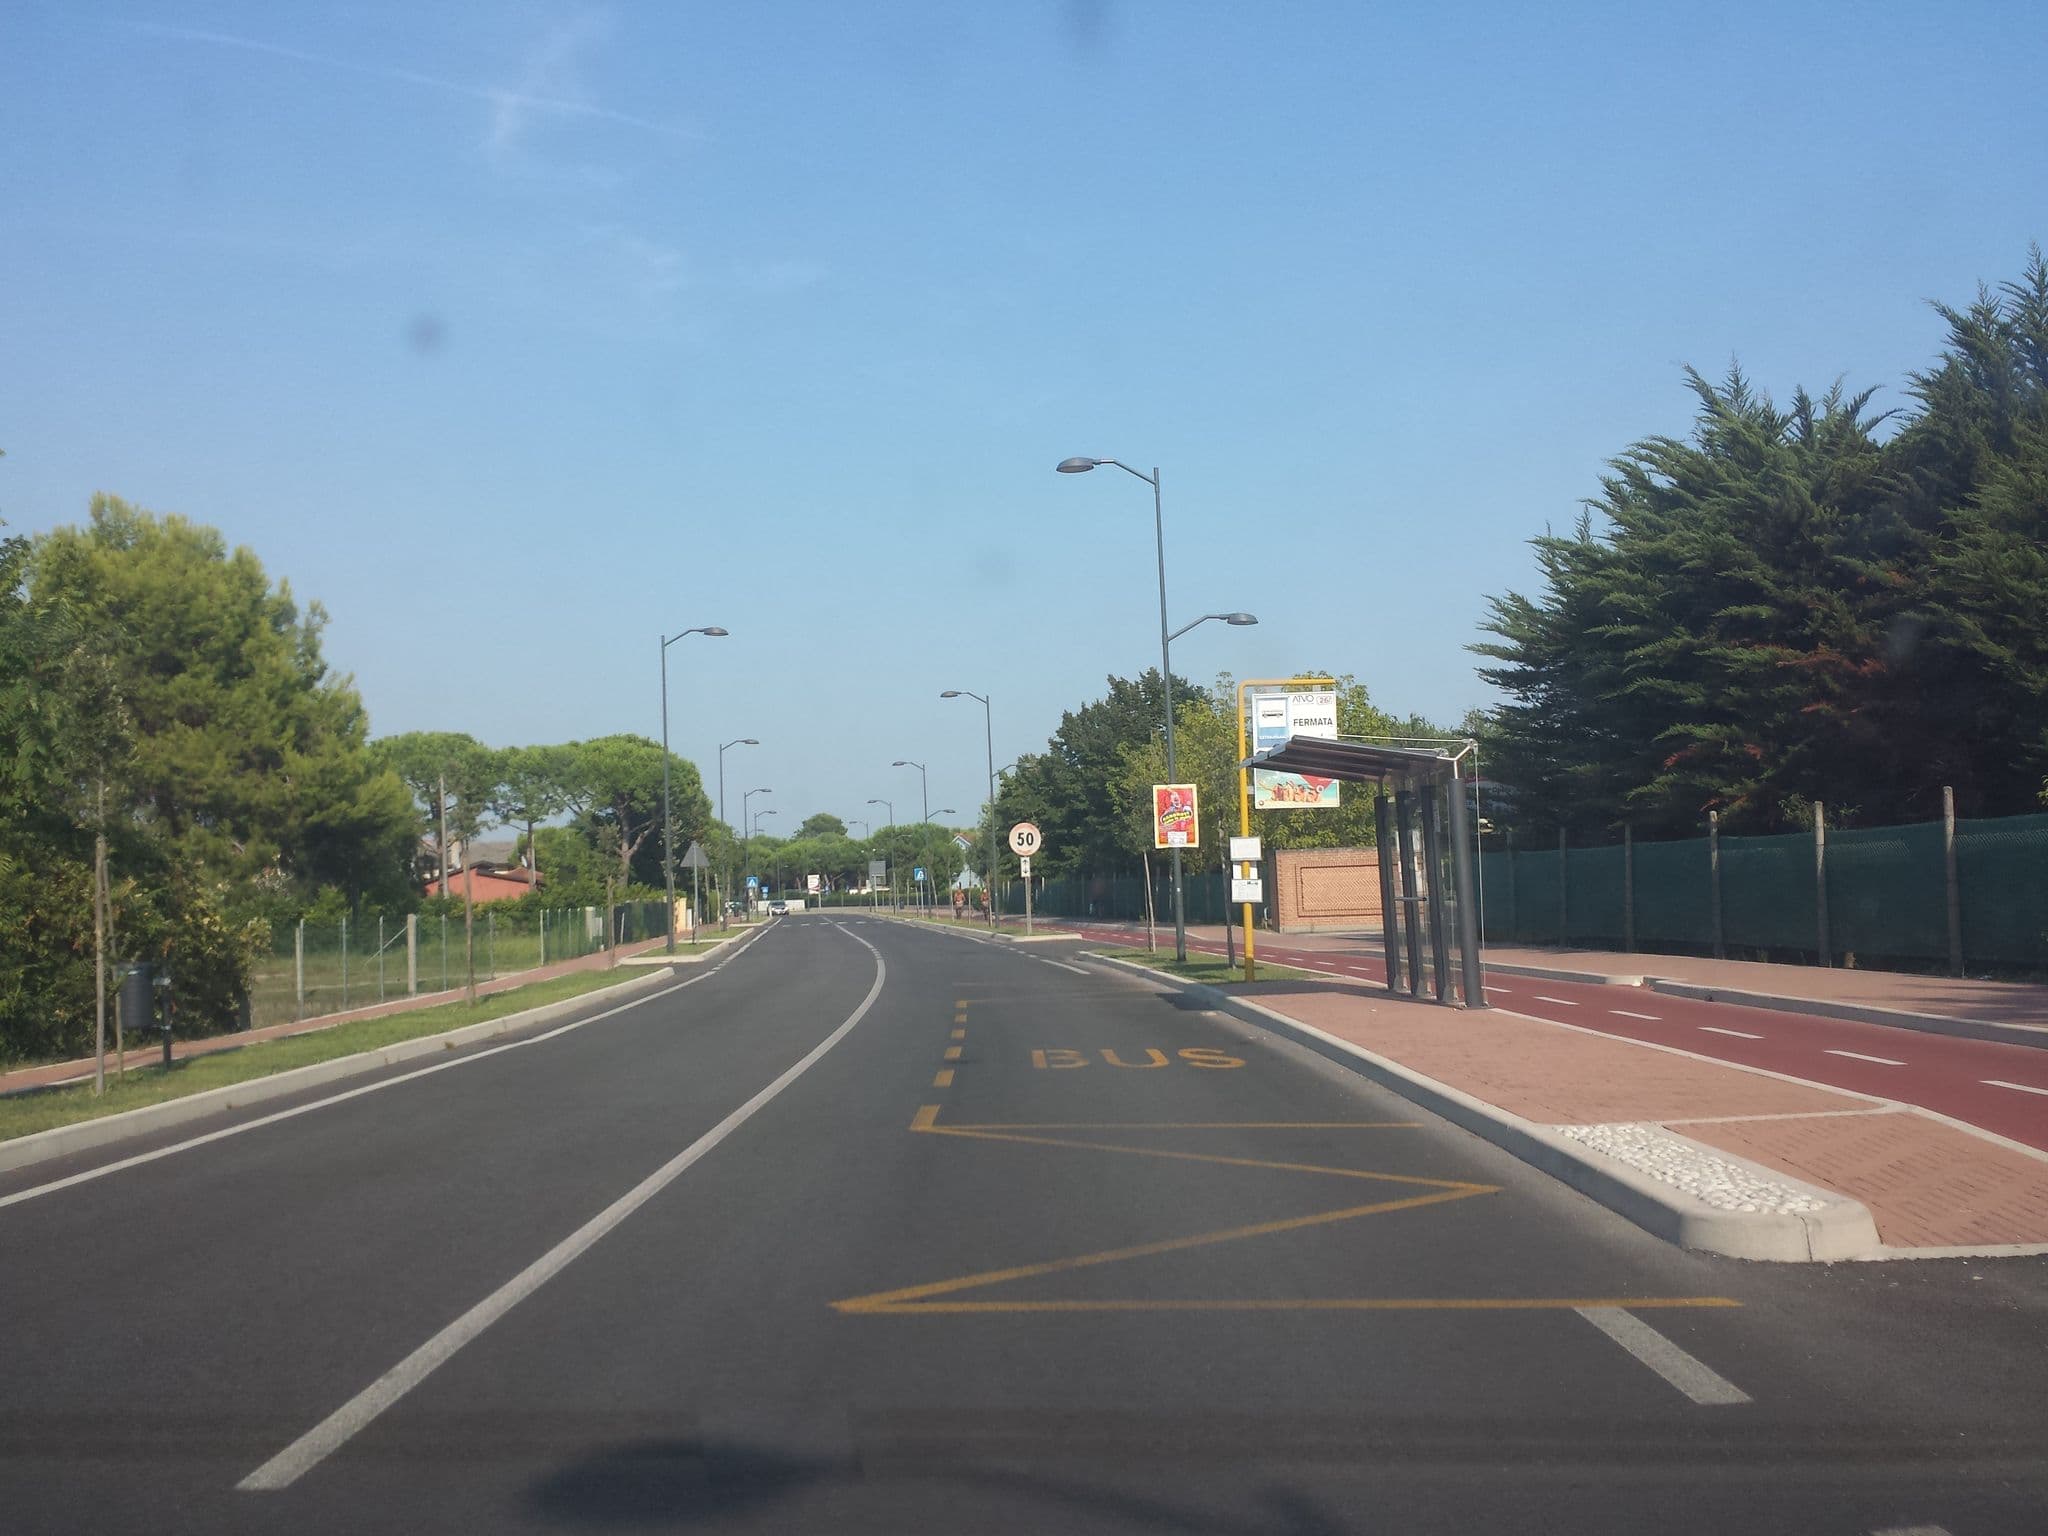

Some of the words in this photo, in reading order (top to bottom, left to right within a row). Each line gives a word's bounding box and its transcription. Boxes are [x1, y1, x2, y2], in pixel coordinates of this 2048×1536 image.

[1293, 717, 1333, 727] FERMATA
[1017, 832, 1034, 846] 50
[1031, 1048, 1246, 1069] BUS
